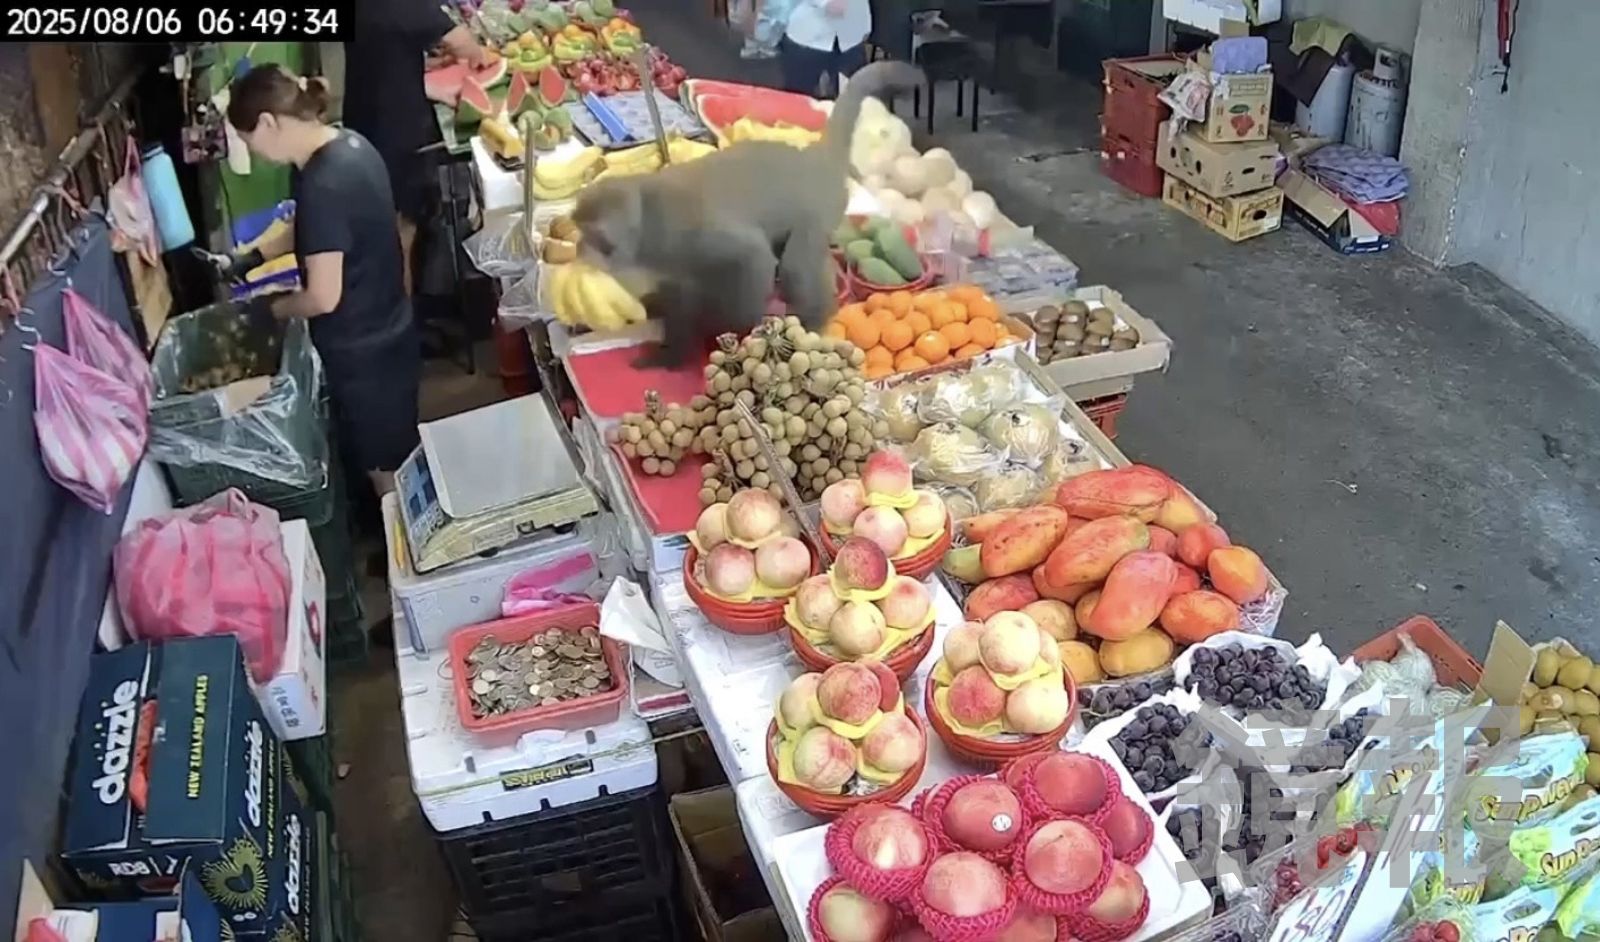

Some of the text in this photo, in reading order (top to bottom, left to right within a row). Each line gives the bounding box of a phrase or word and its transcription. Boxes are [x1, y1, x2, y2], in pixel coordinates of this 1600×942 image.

[92, 681, 139, 804] dazzle
[187, 675, 208, 797] NEW ZEALAND APPLES
[244, 721, 262, 827] dazzle
